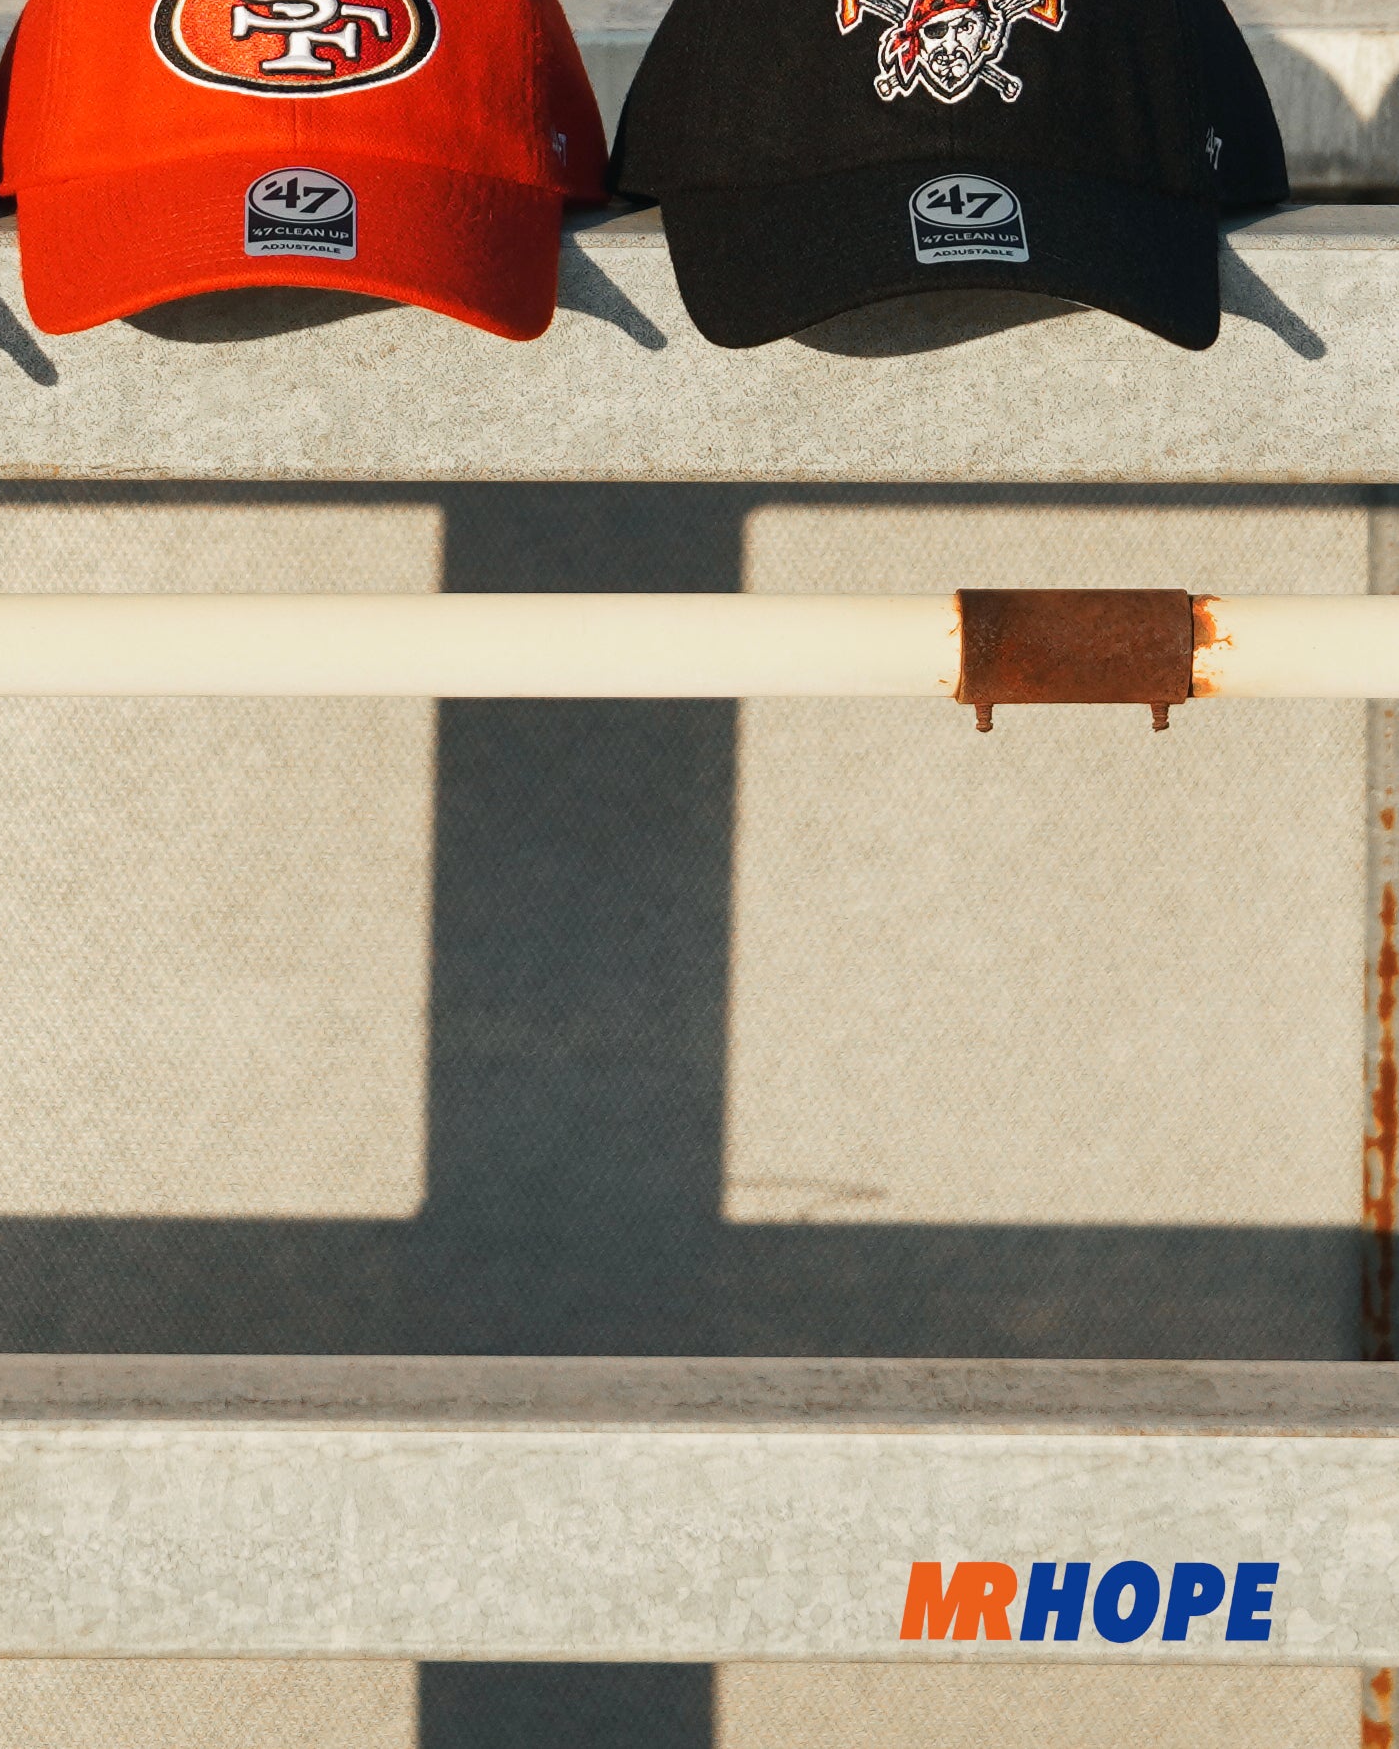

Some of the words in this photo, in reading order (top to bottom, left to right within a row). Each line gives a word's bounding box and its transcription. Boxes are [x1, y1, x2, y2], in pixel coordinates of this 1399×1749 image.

[274, 227, 325, 237] CLEAN
[329, 230, 350, 240] UP
[943, 232, 995, 241] CLEAN
[999, 234, 1020, 243] UP
[261, 244, 342, 254] ADJUSTABLE
[932, 248, 1015, 257] ADJUSTABLE
